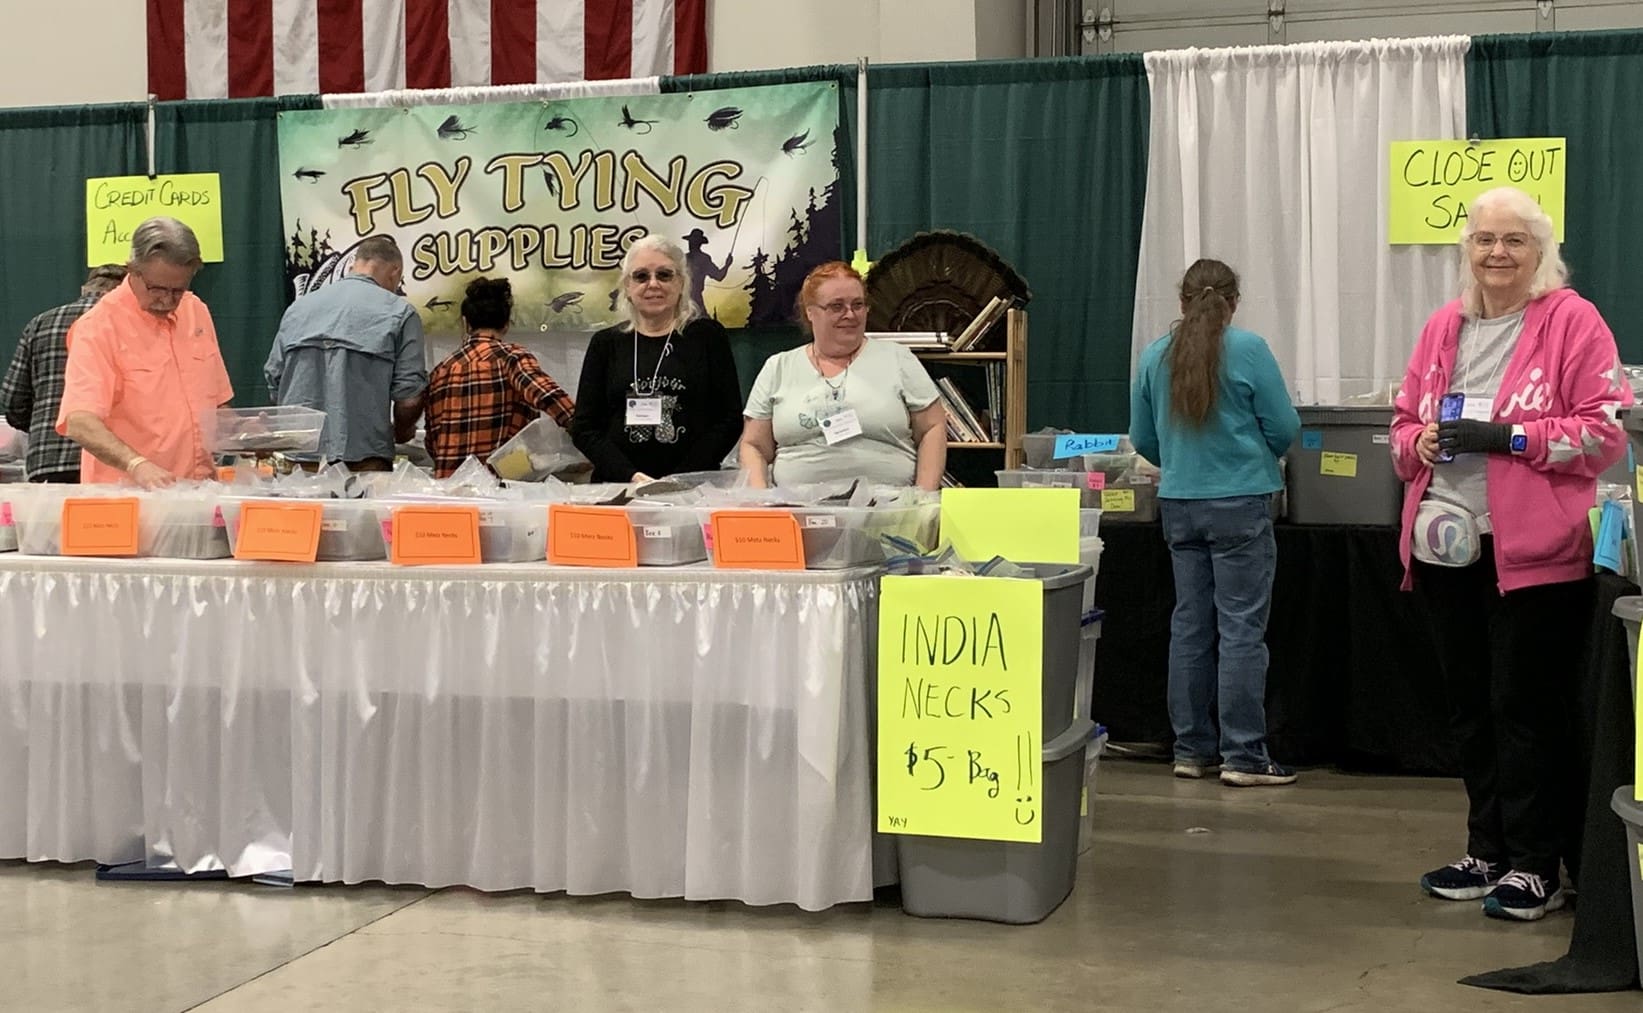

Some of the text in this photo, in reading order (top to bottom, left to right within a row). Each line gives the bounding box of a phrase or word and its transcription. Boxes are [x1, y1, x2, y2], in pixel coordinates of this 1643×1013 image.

[1404, 147, 1561, 187] CLOSE OUT
[95, 180, 210, 210] CREDIT CARDS
[343, 149, 754, 237] FLY TYING
[411, 224, 648, 280] SUPPLIES
[1065, 439, 1112, 451] Rabbit
[901, 612, 1007, 671] INDIA
[901, 677, 1011, 720] NECKS
[967, 750, 1000, 799] Bag
[888, 815, 908, 828] YAY
